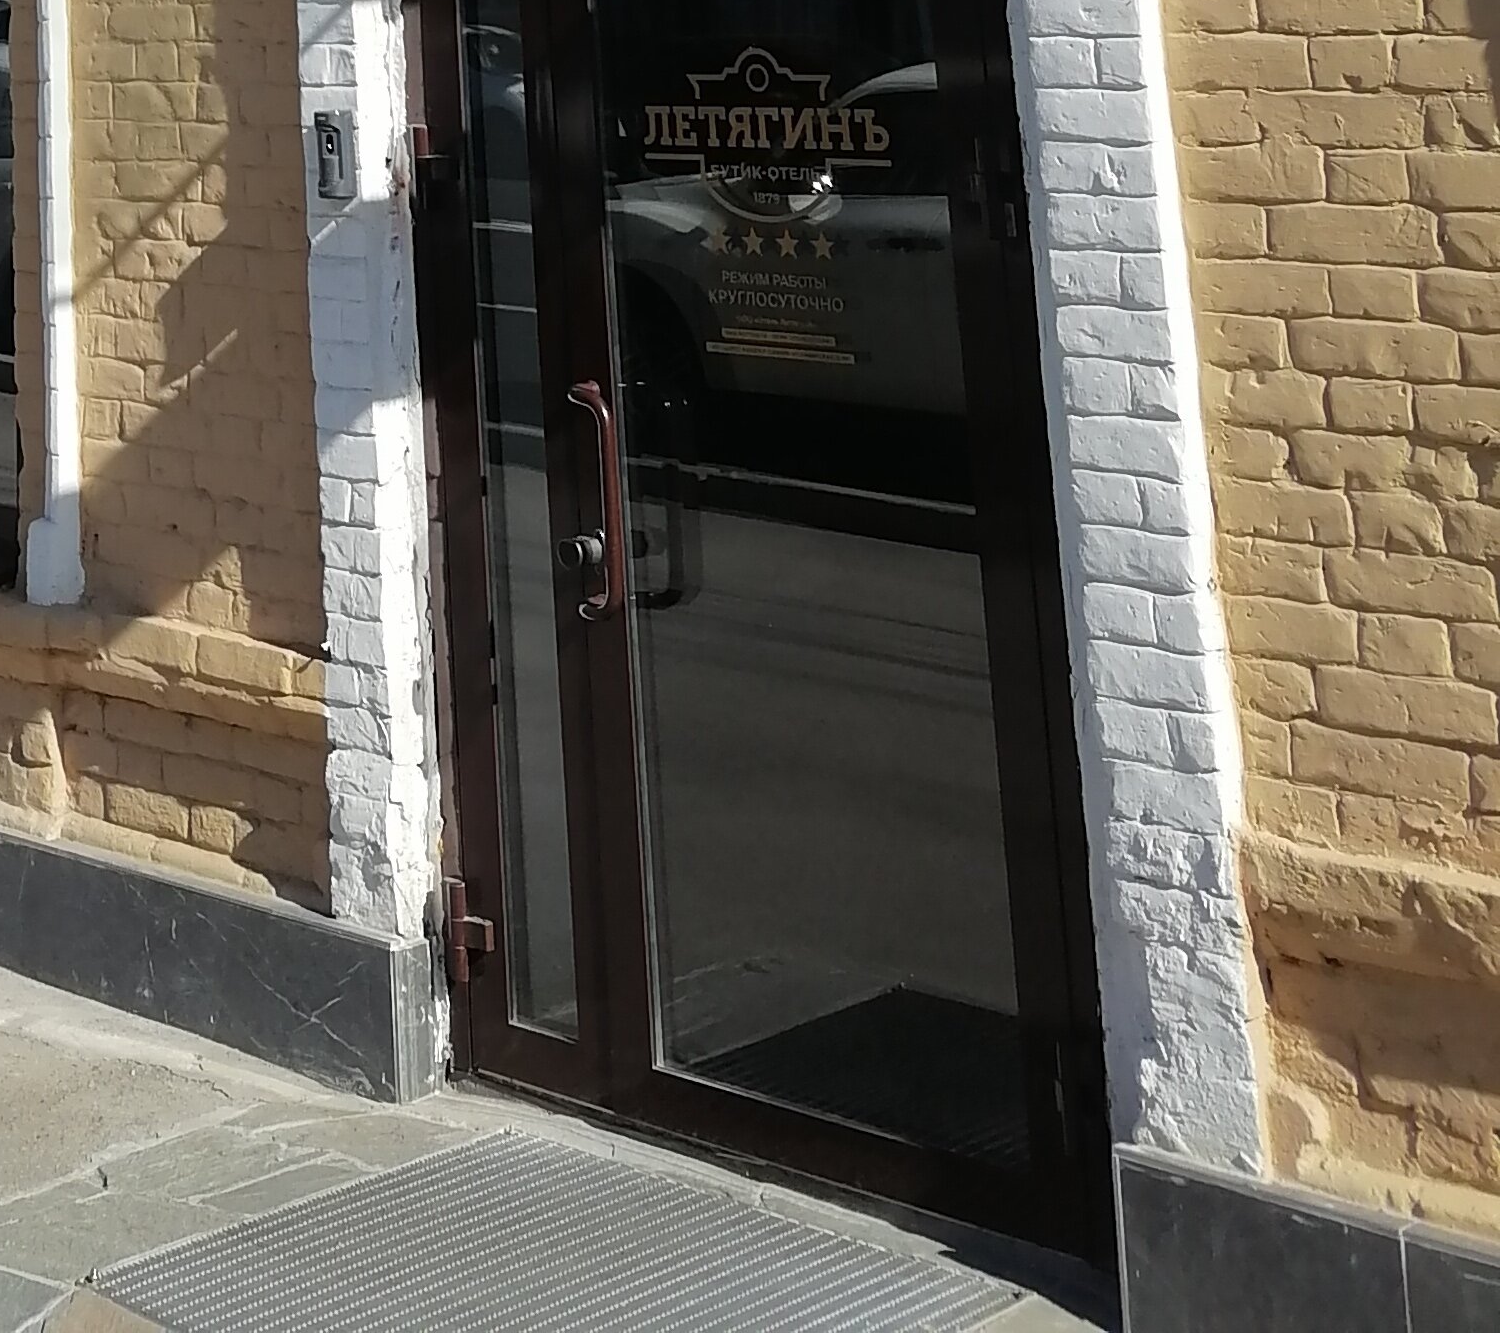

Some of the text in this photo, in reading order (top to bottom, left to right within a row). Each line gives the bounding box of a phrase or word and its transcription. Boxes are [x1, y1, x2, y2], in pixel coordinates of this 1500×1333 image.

[644, 106, 890, 151] ЛЕТЯГИНЪ
[753, 192, 781, 205] 1879
[721, 270, 826, 289] РЕЖИМ РАБОТЫ
[708, 289, 844, 312] КРУГЛОСУТОЧНО
